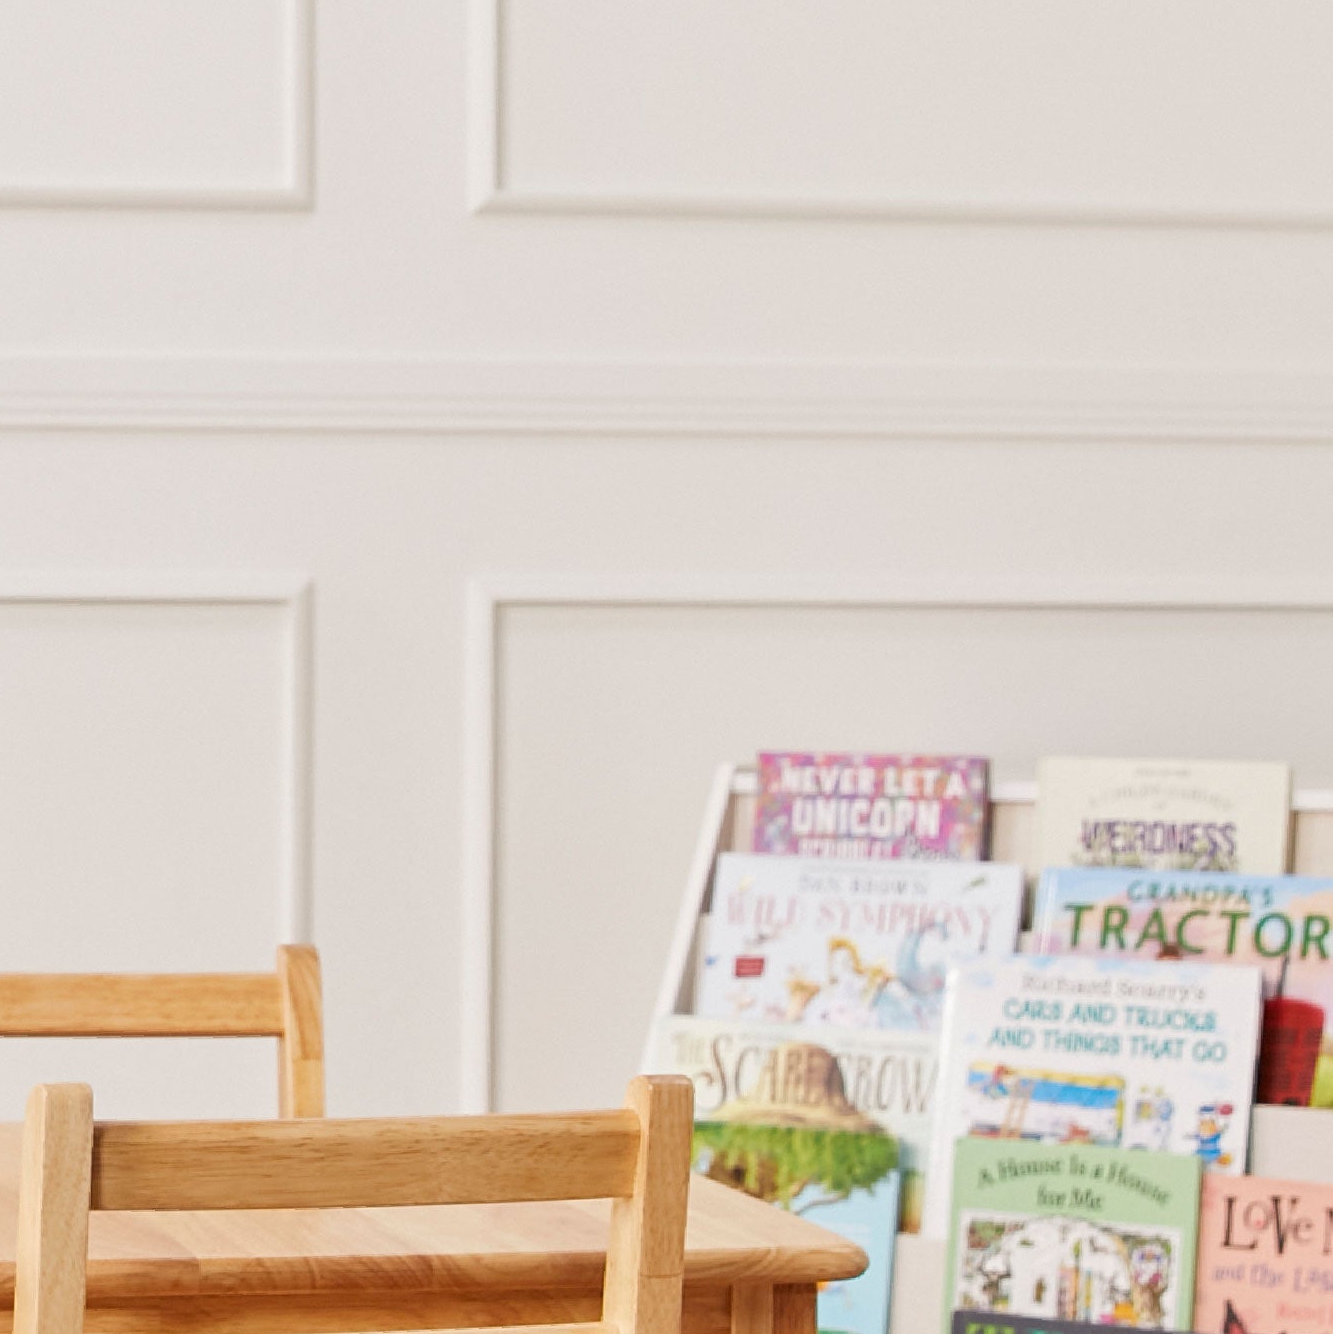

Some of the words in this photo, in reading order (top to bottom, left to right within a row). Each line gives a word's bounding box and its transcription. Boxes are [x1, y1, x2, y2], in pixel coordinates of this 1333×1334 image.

[791, 797, 942, 840] UNICORN
[1064, 901, 1333, 961] TRACTOR
[1003, 997, 1063, 1021] CARS
[1068, 1001, 1118, 1025] AND
[1124, 1004, 1218, 1032] TRUCKS
[988, 1026, 1034, 1050] AND
[1043, 1029, 1121, 1056] THINGS
[1131, 1034, 1188, 1060] THAT
[1191, 1040, 1229, 1063] GO
